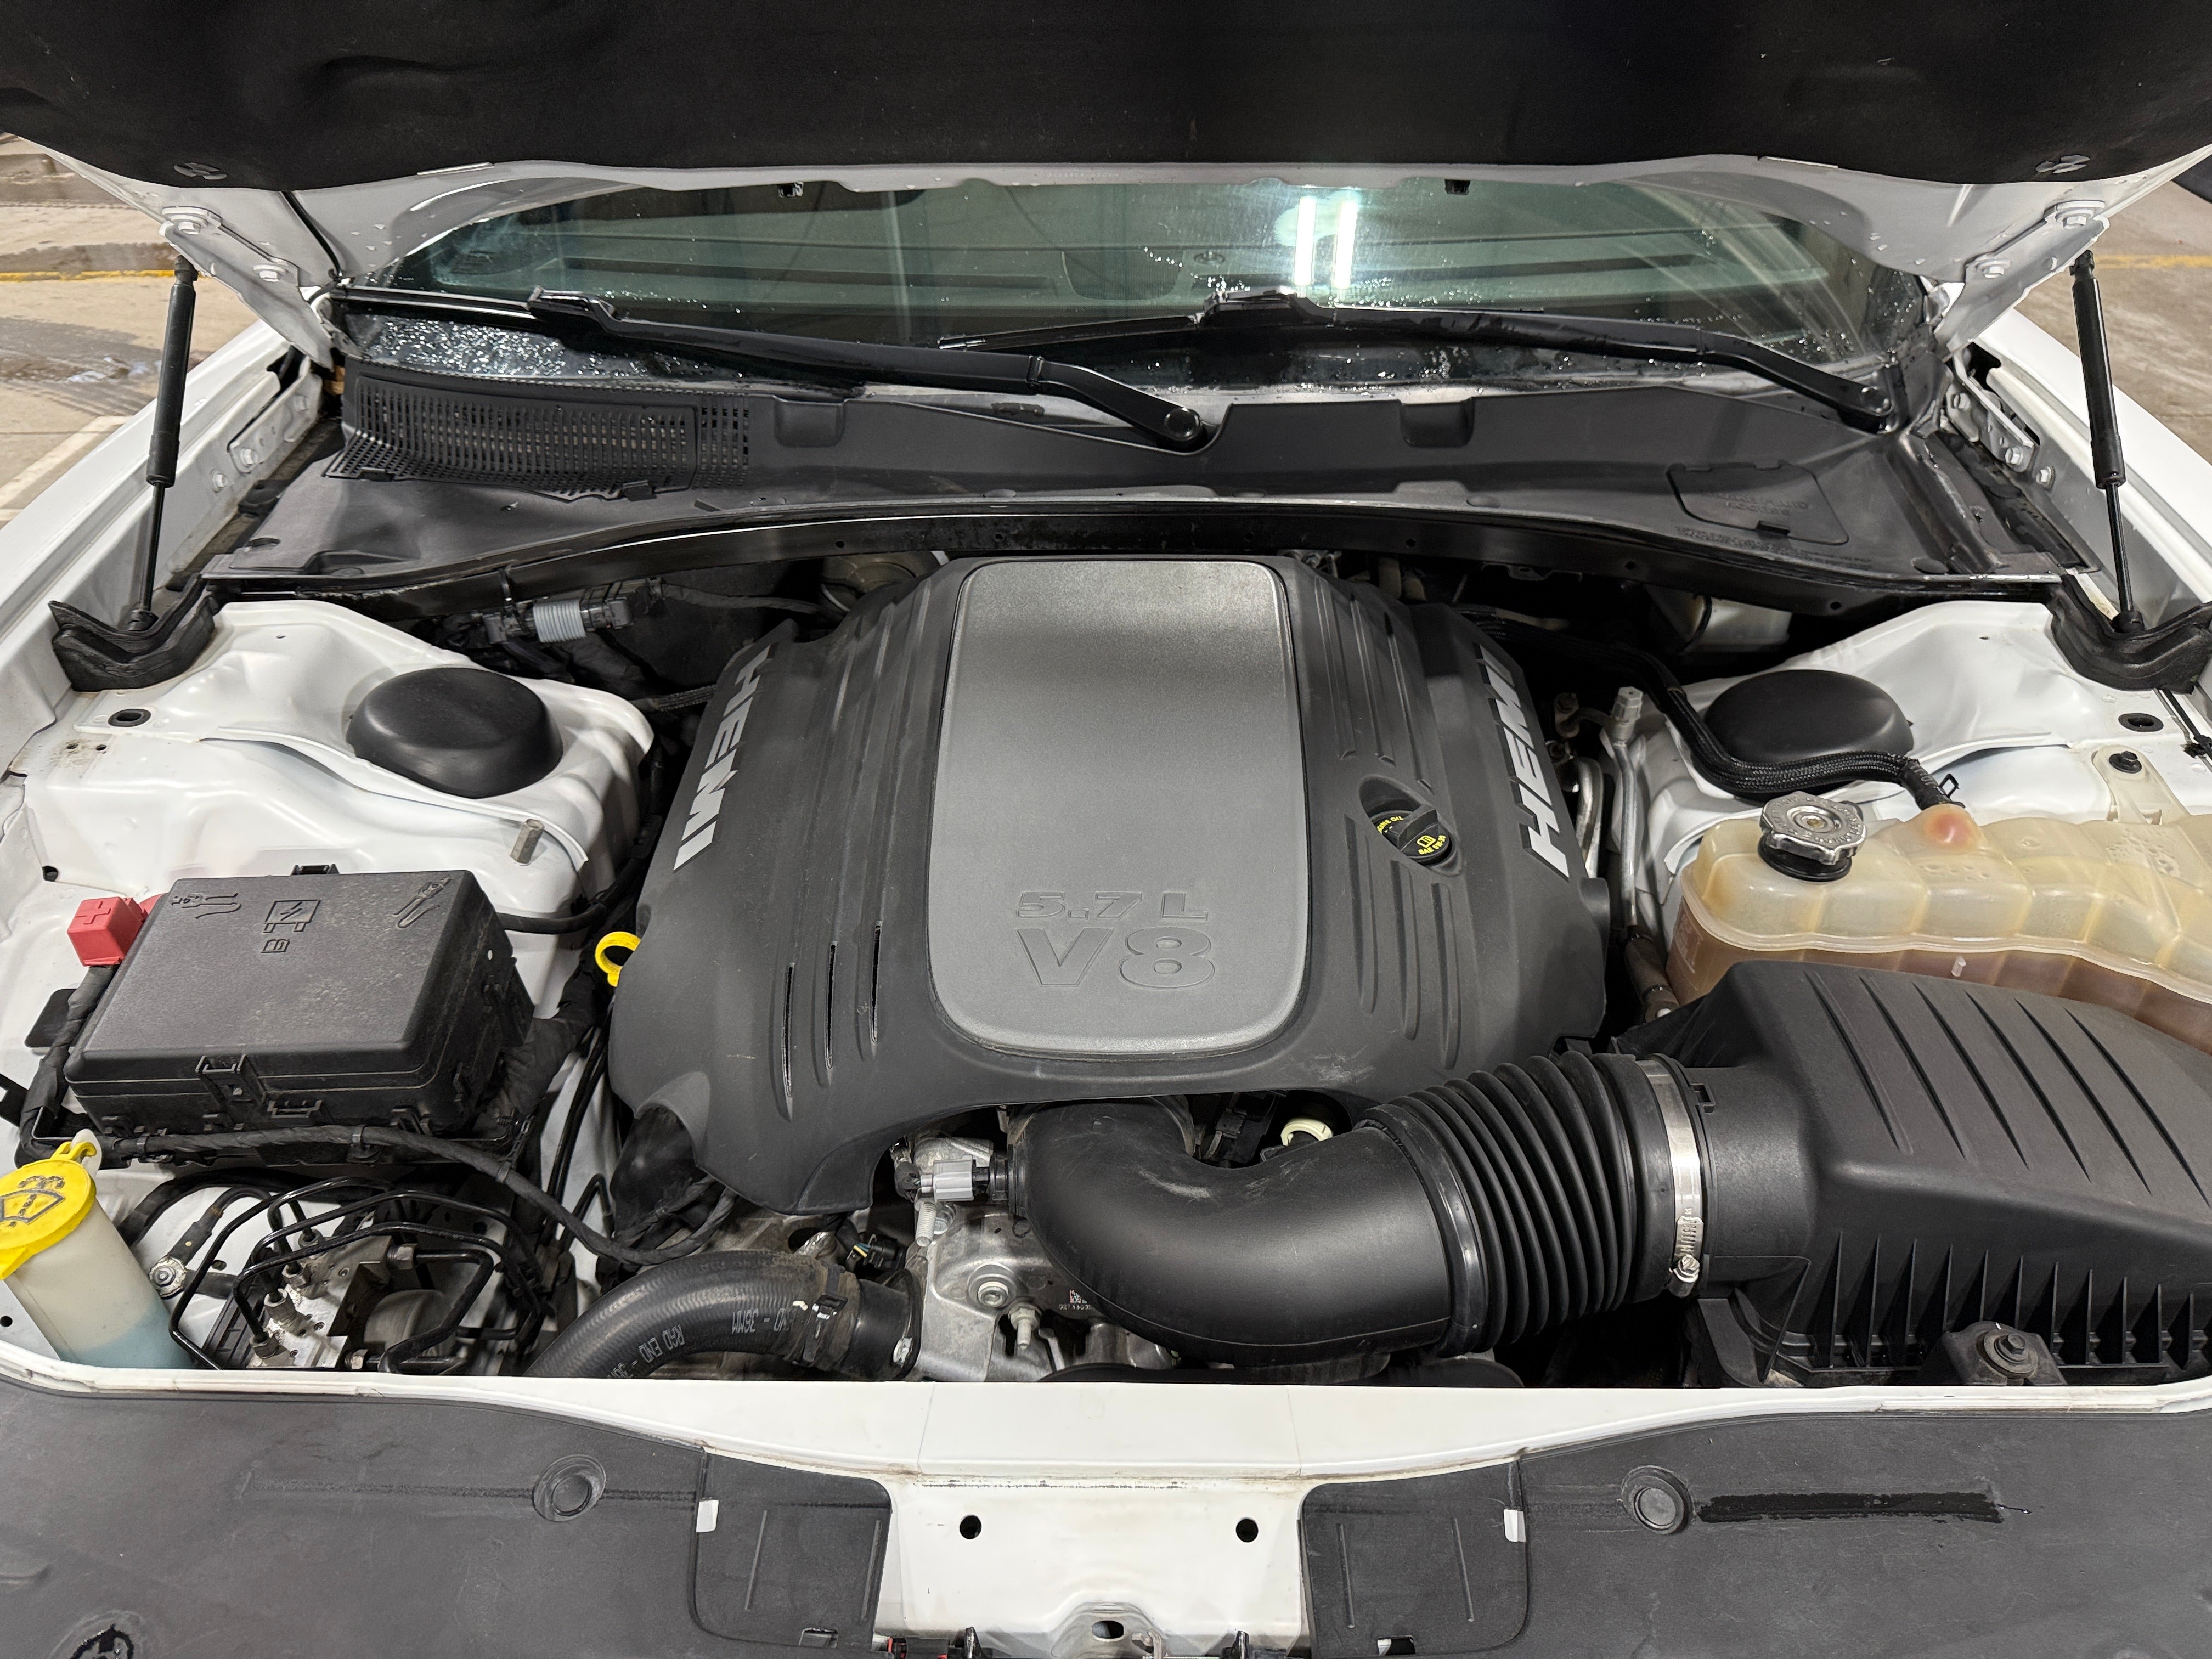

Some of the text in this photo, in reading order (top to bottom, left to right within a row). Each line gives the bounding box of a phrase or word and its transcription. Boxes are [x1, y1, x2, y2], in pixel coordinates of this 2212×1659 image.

[673, 645, 771, 871] HEMI
[1478, 644, 1570, 879] HEMI
[1377, 819, 1391, 834] GINE
[1418, 834, 1446, 855] SAE 5W-20
[1015, 891, 1208, 921] 5.7 L
[1016, 927, 1215, 989] V8
[731, 1307, 759, 1334] 36MM
[638, 1337, 663, 1363] END
[662, 1323, 685, 1351] RAD
